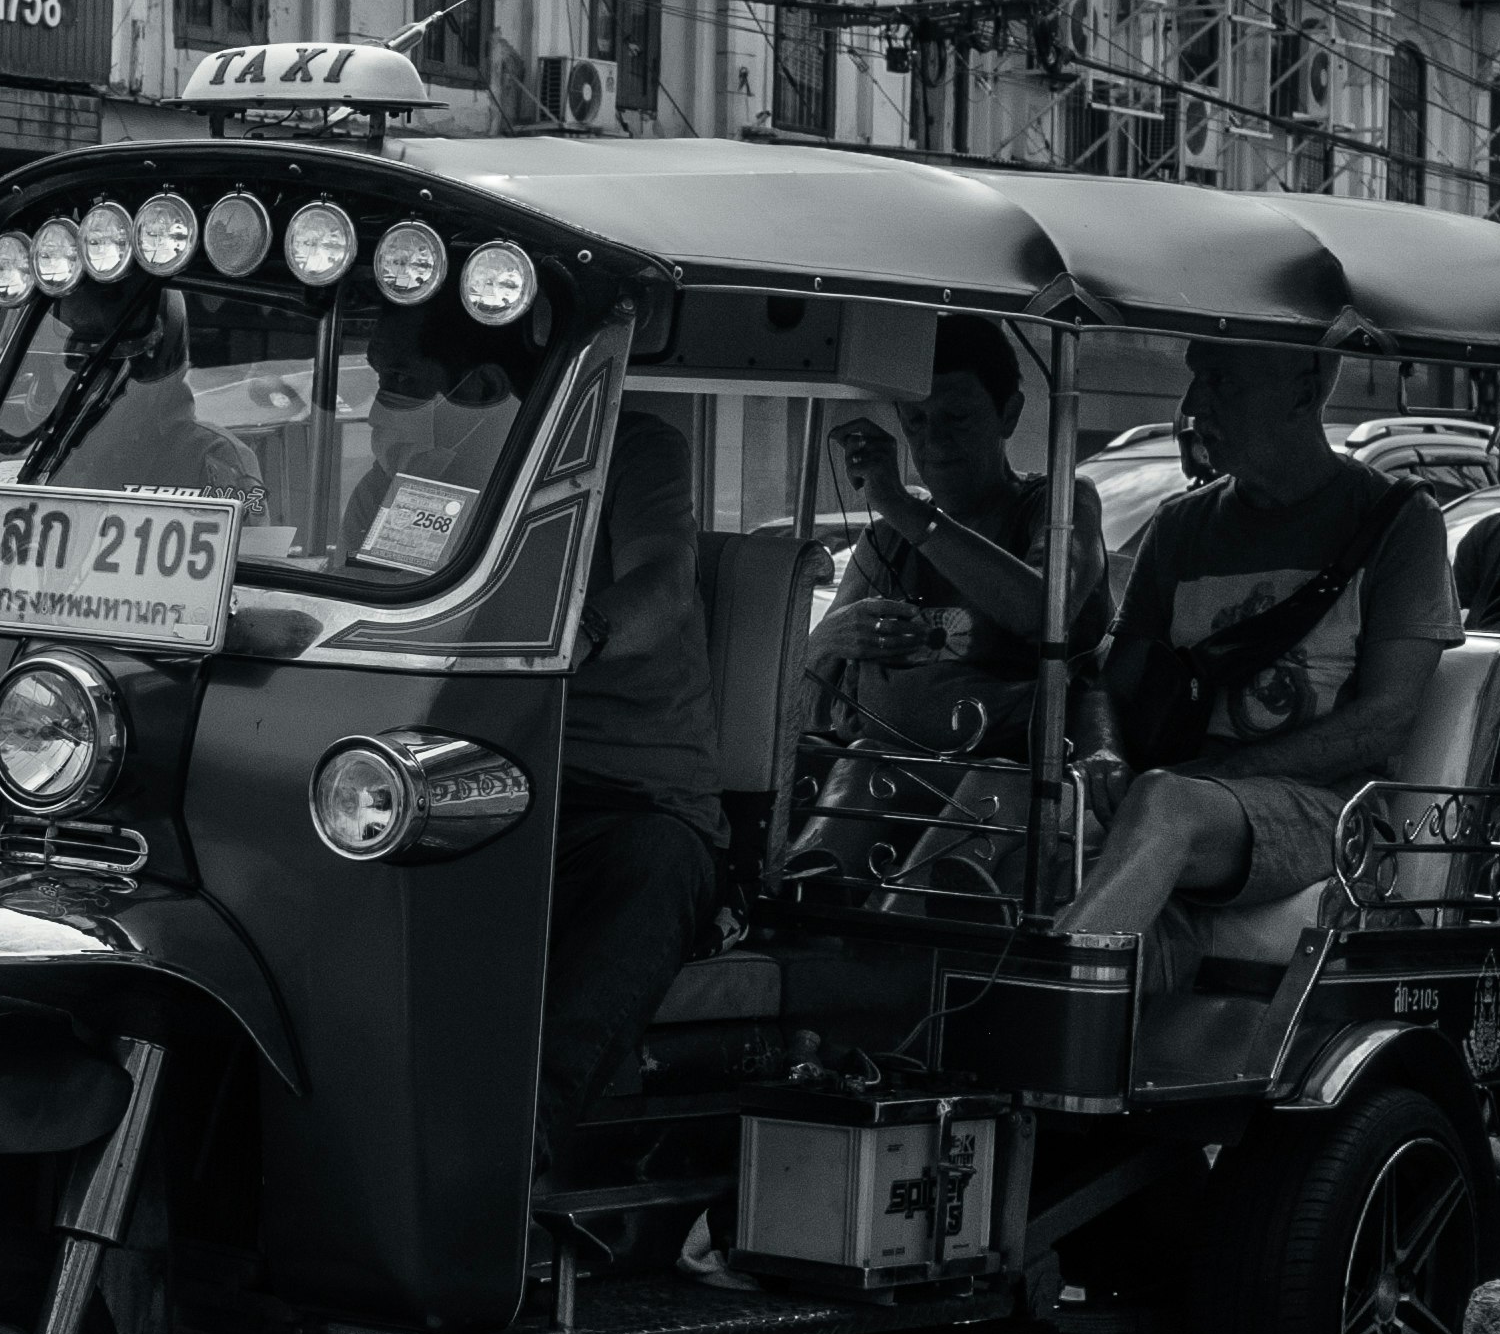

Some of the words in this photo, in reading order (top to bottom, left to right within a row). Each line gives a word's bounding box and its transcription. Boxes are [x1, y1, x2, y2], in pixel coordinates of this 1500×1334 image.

[209, 47, 356, 85] TAXI
[412, 511, 453, 534] 2568
[0, 503, 69, 570] สก
[93, 514, 220, 581] 2105
